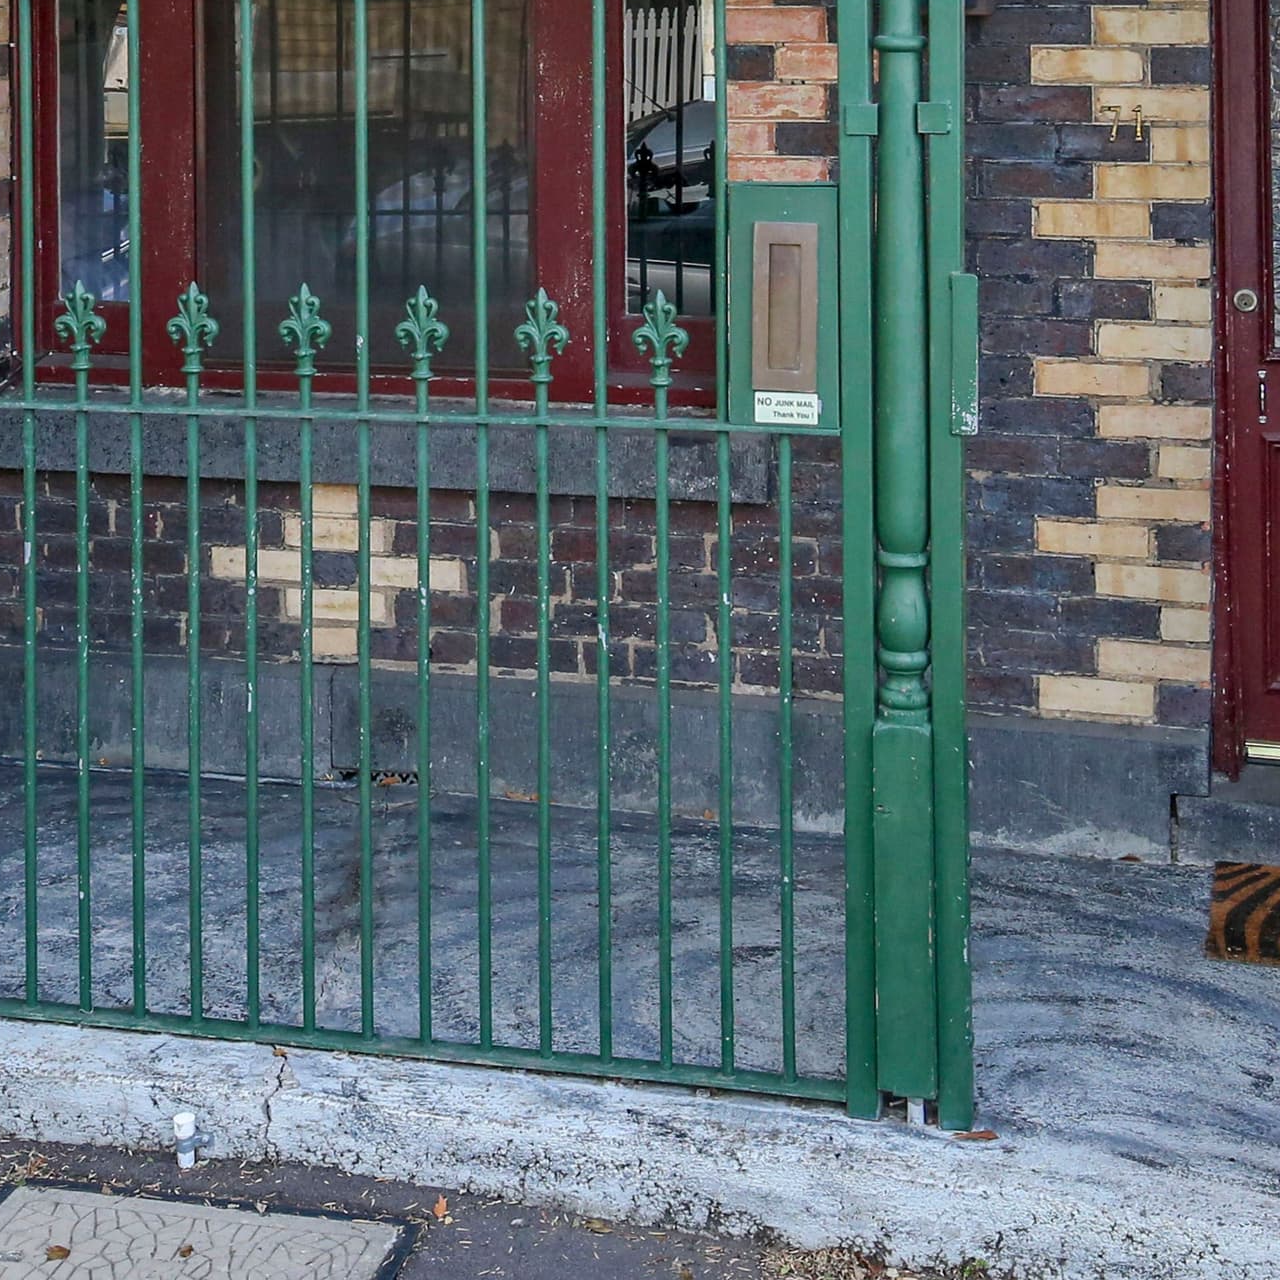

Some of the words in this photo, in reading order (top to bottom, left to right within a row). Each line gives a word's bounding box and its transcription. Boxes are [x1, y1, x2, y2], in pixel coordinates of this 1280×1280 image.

[1100, 105, 1143, 142] 71
[757, 397, 772, 406] NO
[796, 401, 814, 409] MAIL
